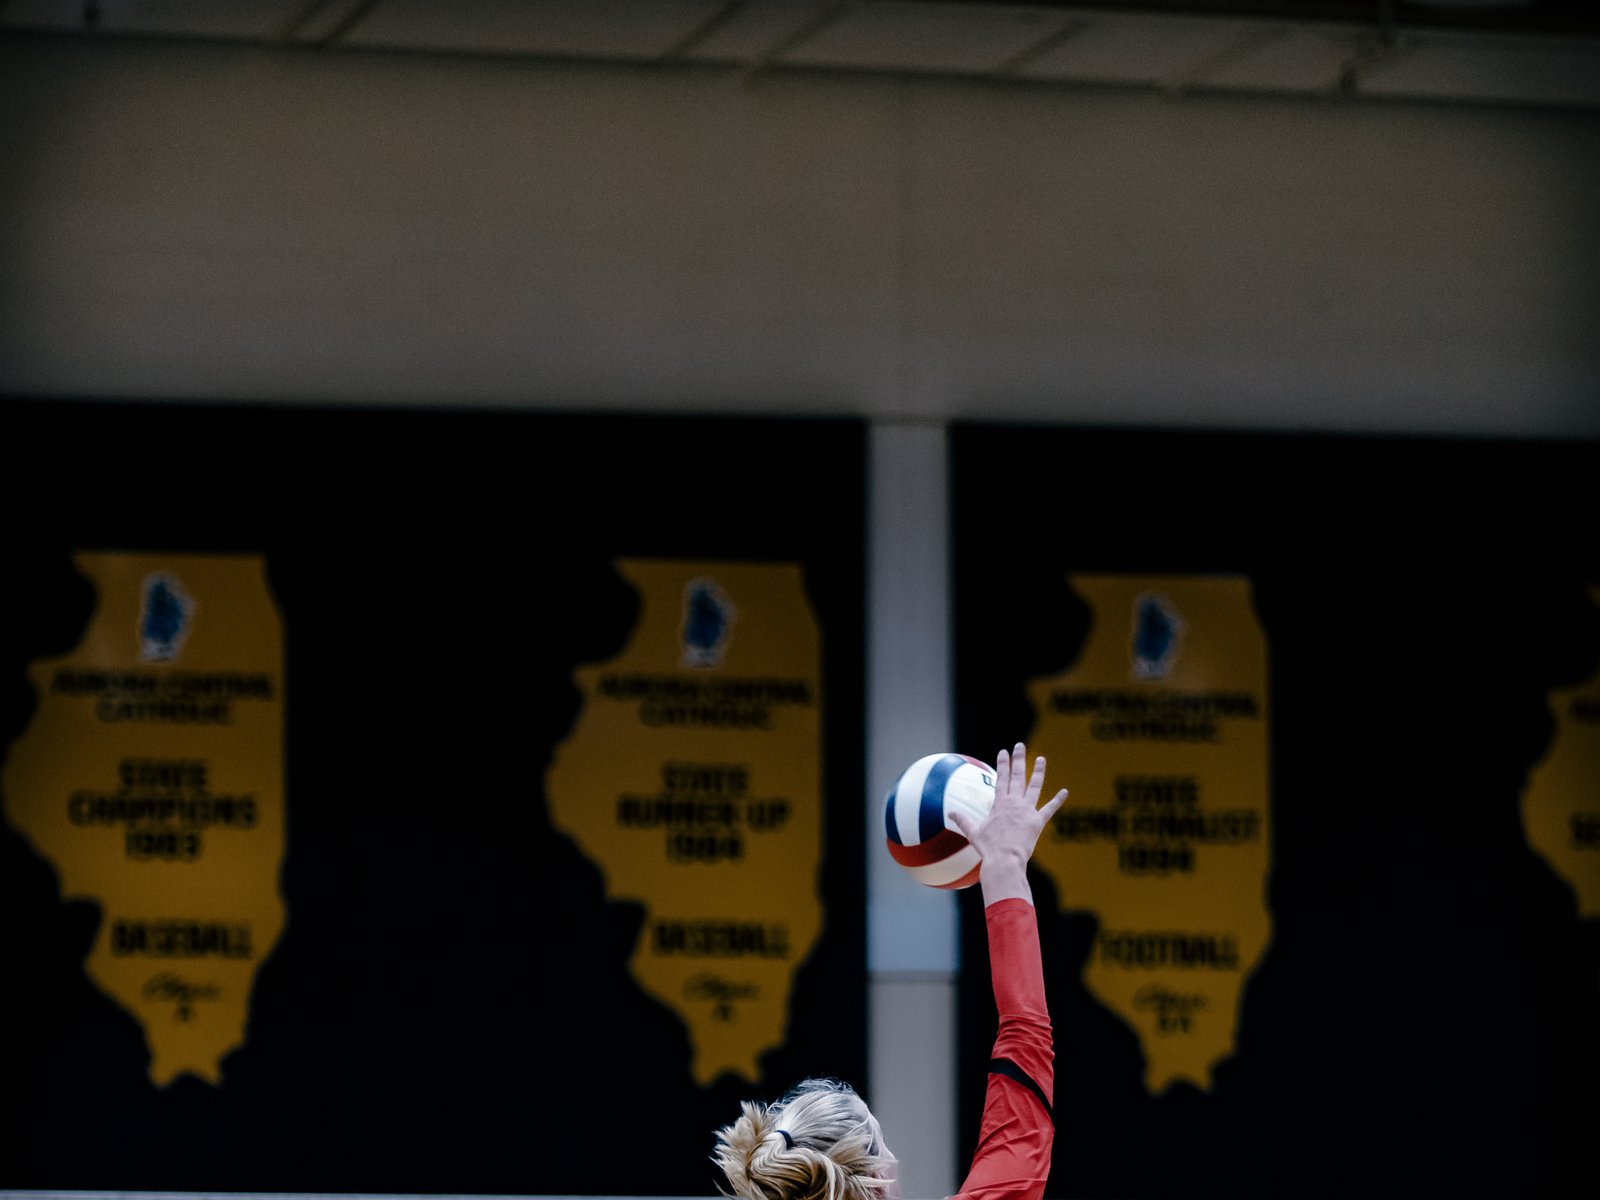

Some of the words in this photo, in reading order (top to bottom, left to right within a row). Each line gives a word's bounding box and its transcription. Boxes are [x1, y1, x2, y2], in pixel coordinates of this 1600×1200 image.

[119, 757, 207, 790] STATE
[661, 760, 751, 793] STATE
[1113, 775, 1202, 806] STATE
[67, 790, 259, 829] CHAMPIONS
[110, 917, 254, 959] BASEBALL
[653, 917, 792, 959] BASEBALL
[1102, 932, 1240, 970] FOOTBALL
